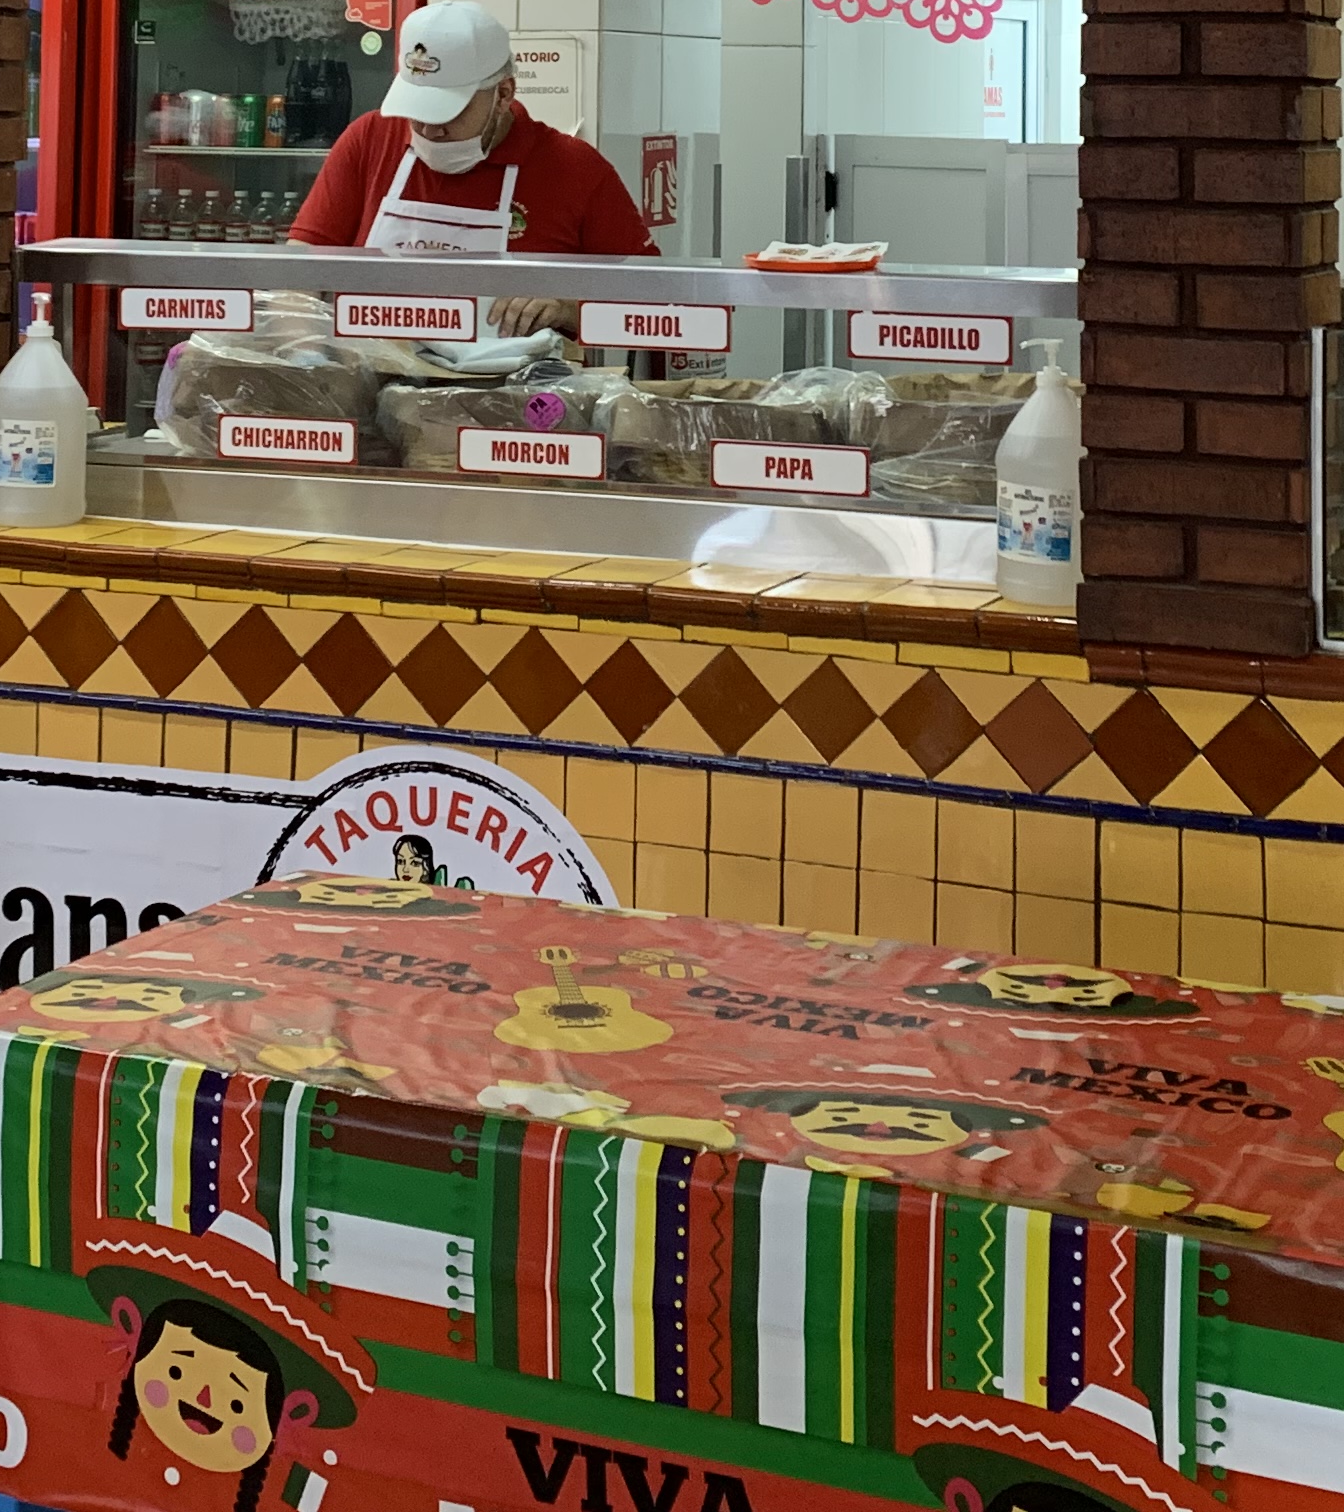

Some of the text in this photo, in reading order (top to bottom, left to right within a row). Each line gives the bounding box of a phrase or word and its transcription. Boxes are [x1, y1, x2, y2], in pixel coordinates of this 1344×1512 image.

[145, 297, 226, 320] CARNITAS
[348, 304, 463, 330] DESHEBRADA
[623, 313, 683, 338] FRIJOL
[878, 324, 981, 352] PICADILLO
[231, 426, 344, 452] CHICHARRON
[491, 440, 570, 465] MORCON
[764, 456, 814, 481] PAPA
[304, 784, 554, 897] TAQUERIA
[261, 952, 492, 995] MEXICO
[340, 944, 472, 976] VIVA
[1087, 1058, 1251, 1096] VIVA
[1010, 1066, 1293, 1120] MEXICO
